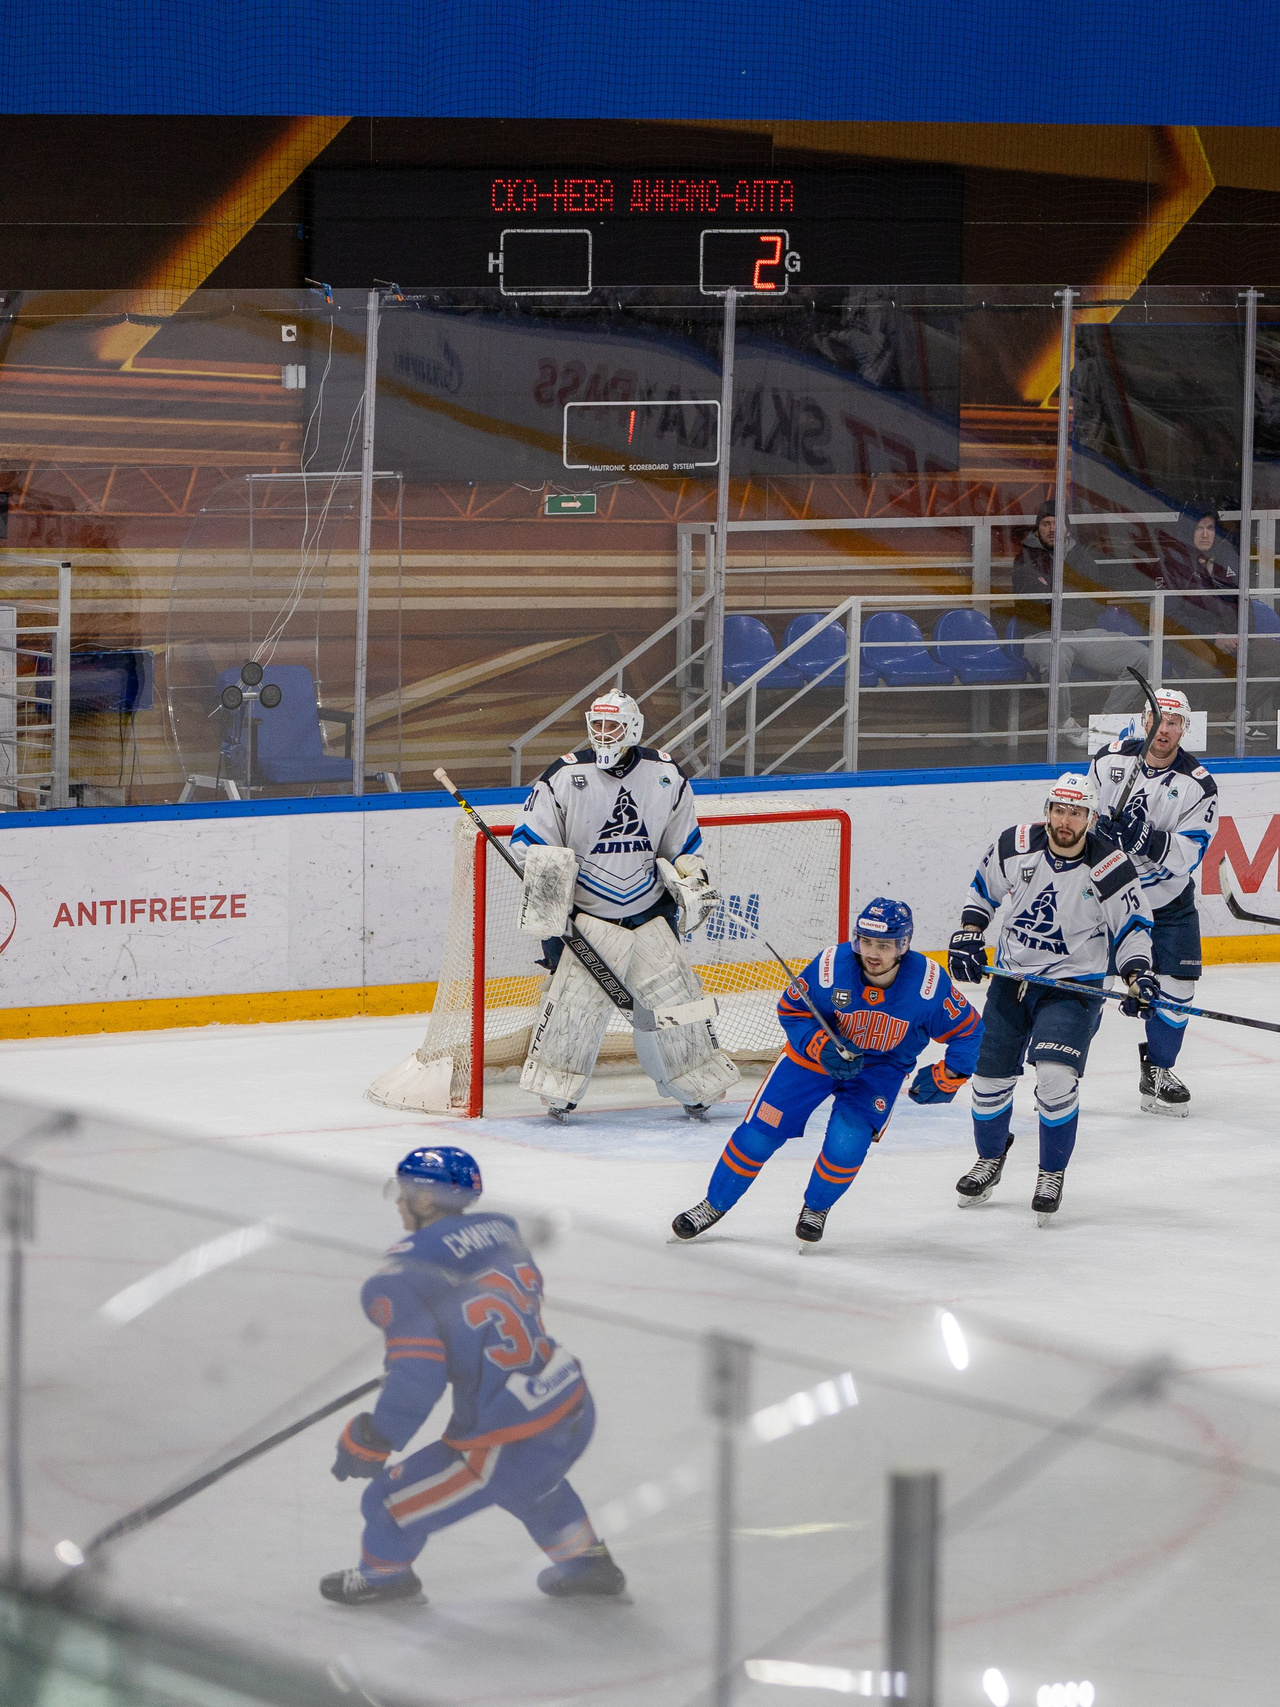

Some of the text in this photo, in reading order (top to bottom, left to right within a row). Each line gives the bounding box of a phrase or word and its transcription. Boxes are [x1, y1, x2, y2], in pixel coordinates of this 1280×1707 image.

[491, 179, 794, 213] СКА-НЕВА ДИНАМО-АЛТА
[488, 252, 504, 274] H
[753, 236, 783, 290] 2
[785, 251, 801, 273] G
[588, 464, 625, 472] NAUTRONIC
[629, 463, 669, 471] SCOREBOARD
[1055, 789, 1082, 798] OLIMPBET
[1066, 778, 1078, 786] 75
[1204, 801, 1217, 824] 5
[1093, 852, 1124, 878] OLIMPBET
[53, 894, 247, 928] ANTIFREEZE
[1120, 886, 1142, 915] 75
[570, 938, 630, 1004] BAUER
[943, 985, 967, 1020] 19
[532, 1001, 555, 1053] TRUE
[1035, 1041, 1082, 1058] BAUER
